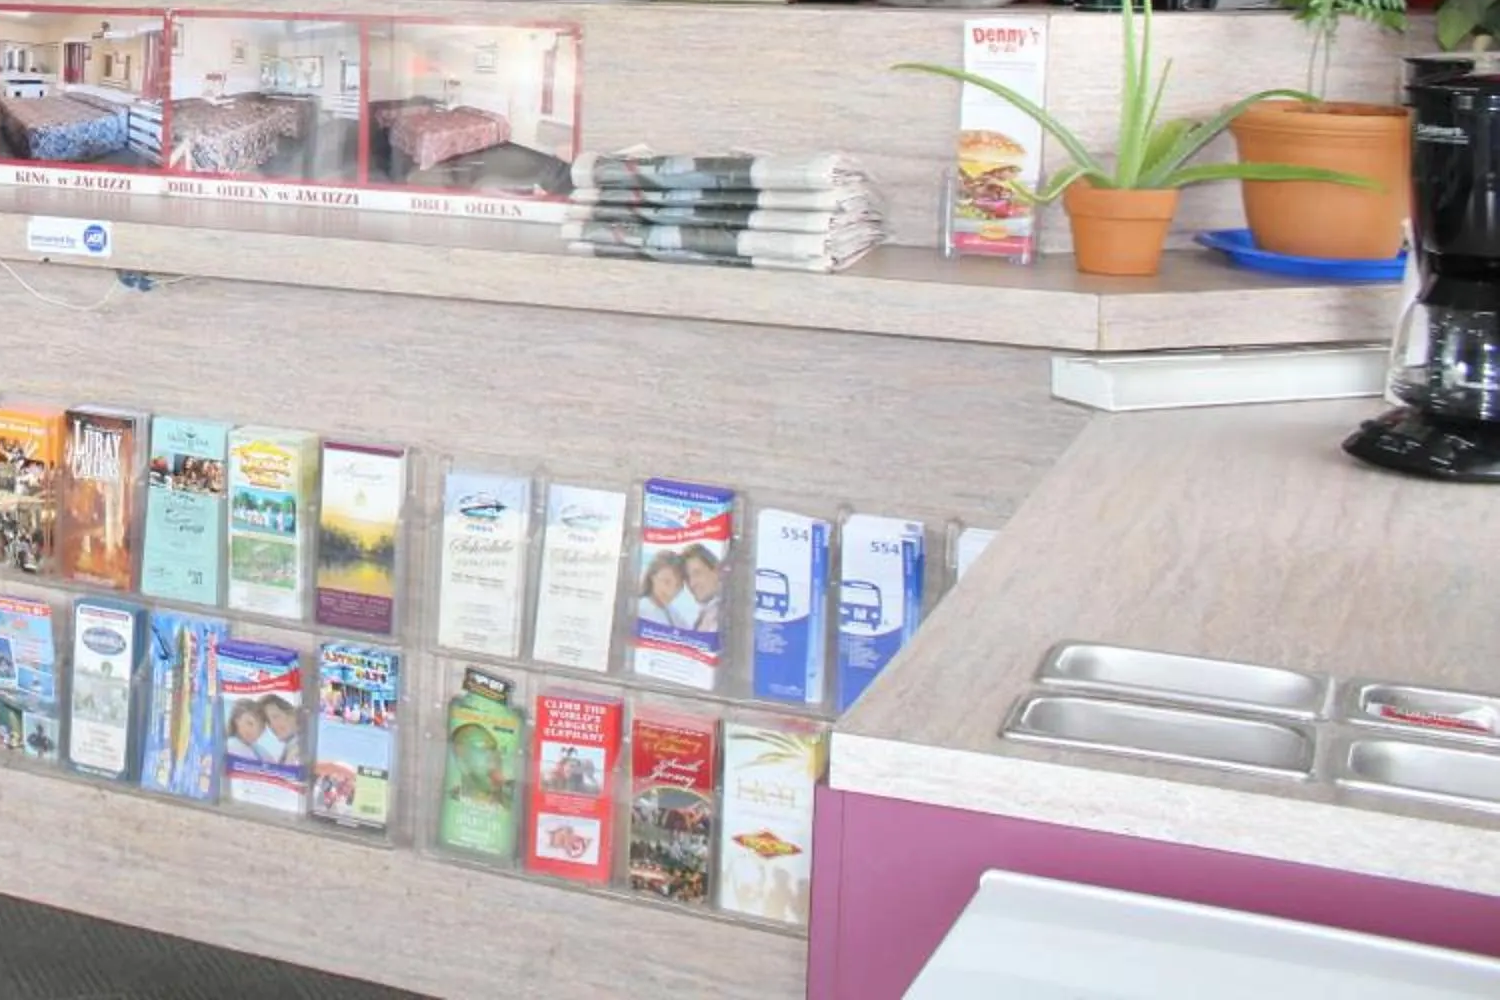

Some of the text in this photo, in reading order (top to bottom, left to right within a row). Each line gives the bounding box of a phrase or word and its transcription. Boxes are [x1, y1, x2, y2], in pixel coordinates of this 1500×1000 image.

[972, 26, 1040, 48] Denny's
[15, 170, 50, 185] KING
[73, 175, 132, 191] JACUZZI
[296, 189, 360, 206] JACUZZI
[781, 526, 810, 542] 554
[870, 541, 900, 556] 554
[544, 700, 607, 715] CLIMB THE
[549, 719, 600, 733] LARGEST
[543, 728, 605, 743] ELEPHANT
